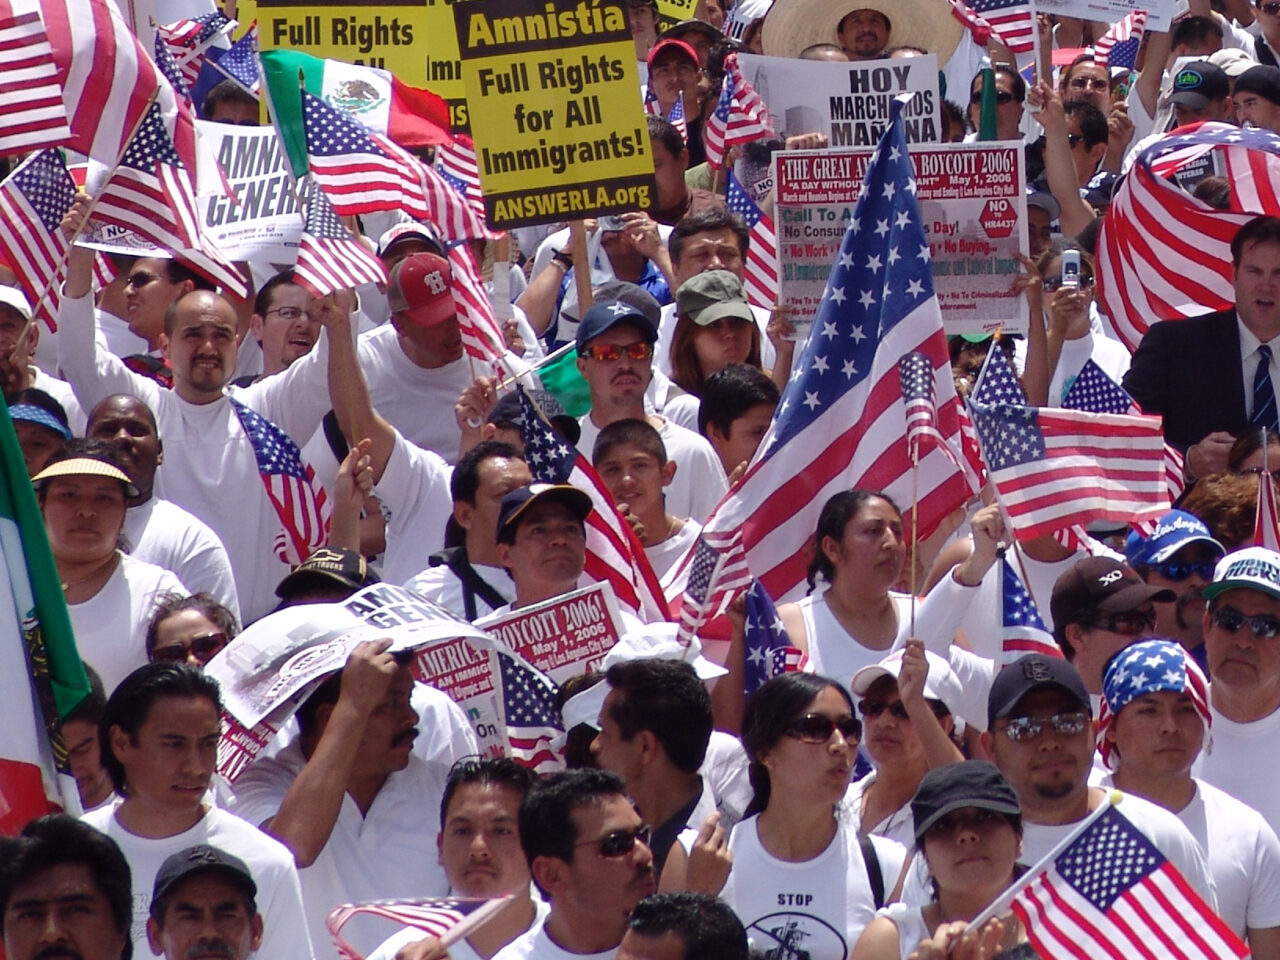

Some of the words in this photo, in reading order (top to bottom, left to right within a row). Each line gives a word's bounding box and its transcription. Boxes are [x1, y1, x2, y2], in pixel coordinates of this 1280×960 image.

[478, 61, 530, 98] Full
[538, 53, 626, 95] Rights
[514, 106, 554, 134] for
[564, 95, 603, 129] All
[482, 128, 645, 176] Immigrants!
[920, 151, 978, 176] BOYCOTT
[980, 147, 1015, 174] 2006!
[494, 184, 651, 222] ANSWERLA.org
[561, 594, 606, 633] 2006!
[777, 893, 813, 907] STOP
